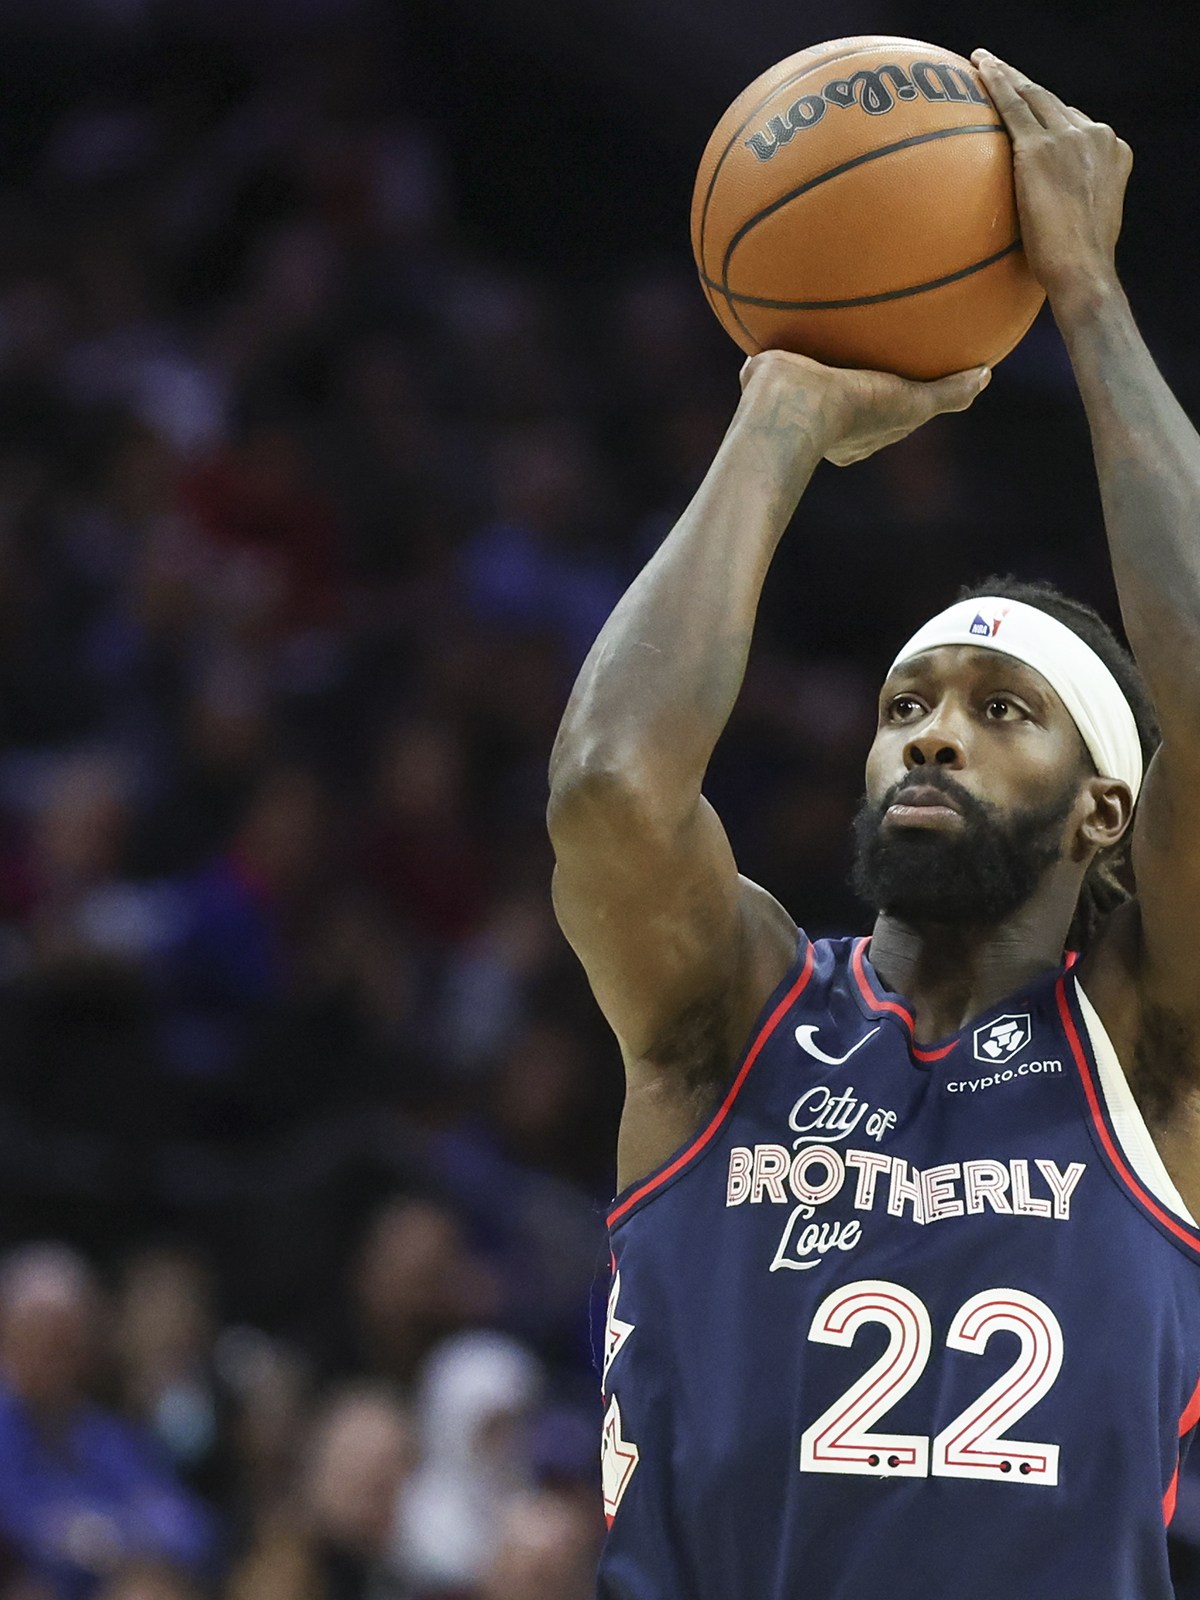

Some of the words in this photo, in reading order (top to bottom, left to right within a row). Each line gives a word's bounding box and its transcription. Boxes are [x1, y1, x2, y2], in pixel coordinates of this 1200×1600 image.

[745, 61, 993, 162] Wilson
[946, 1059, 1063, 1093] crypto.com
[788, 1086, 869, 1150] City
[865, 1107, 897, 1142] of
[726, 1144, 1087, 1226] BROTHERLY
[769, 1204, 862, 1273] Love
[799, 1279, 1064, 1487] 22
